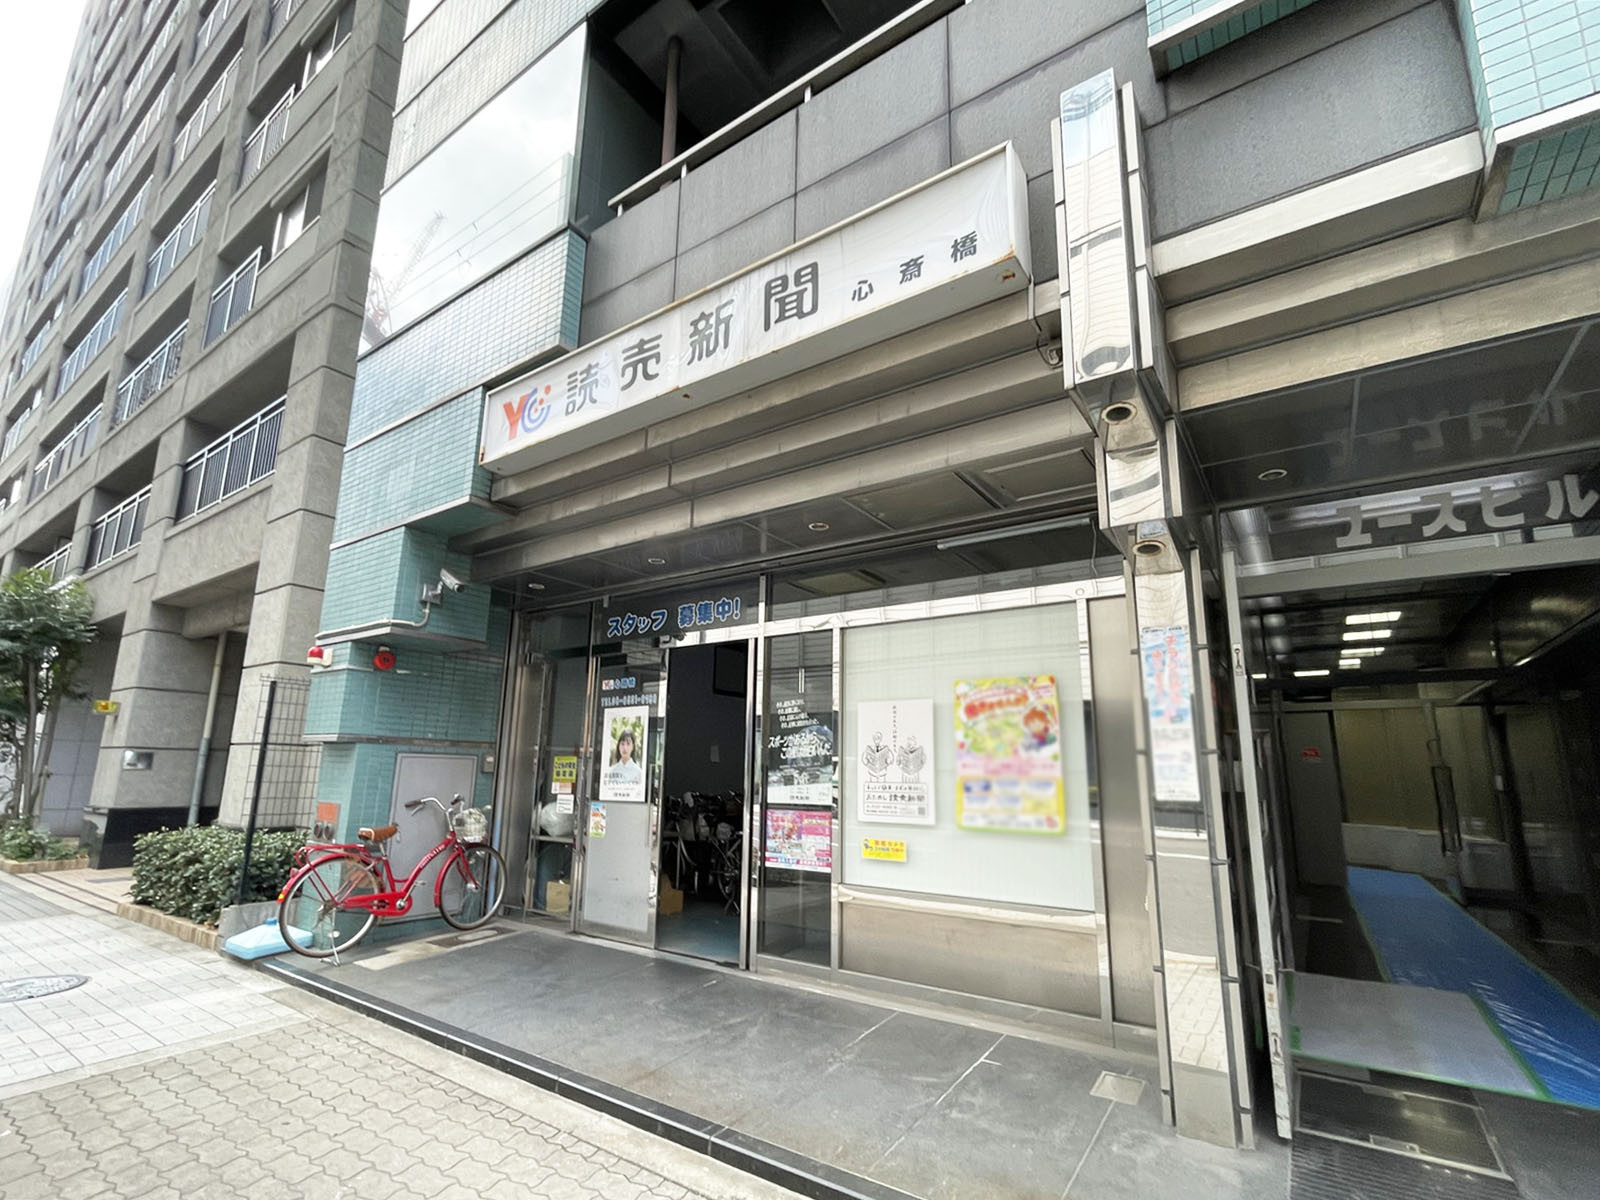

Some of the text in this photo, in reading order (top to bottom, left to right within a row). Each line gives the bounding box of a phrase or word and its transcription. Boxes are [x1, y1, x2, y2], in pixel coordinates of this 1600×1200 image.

[565, 261, 819, 416] 読売新聞
[851, 230, 978, 302] 心斎橋
[607, 597, 742, 638] スタッフ 募集中!
